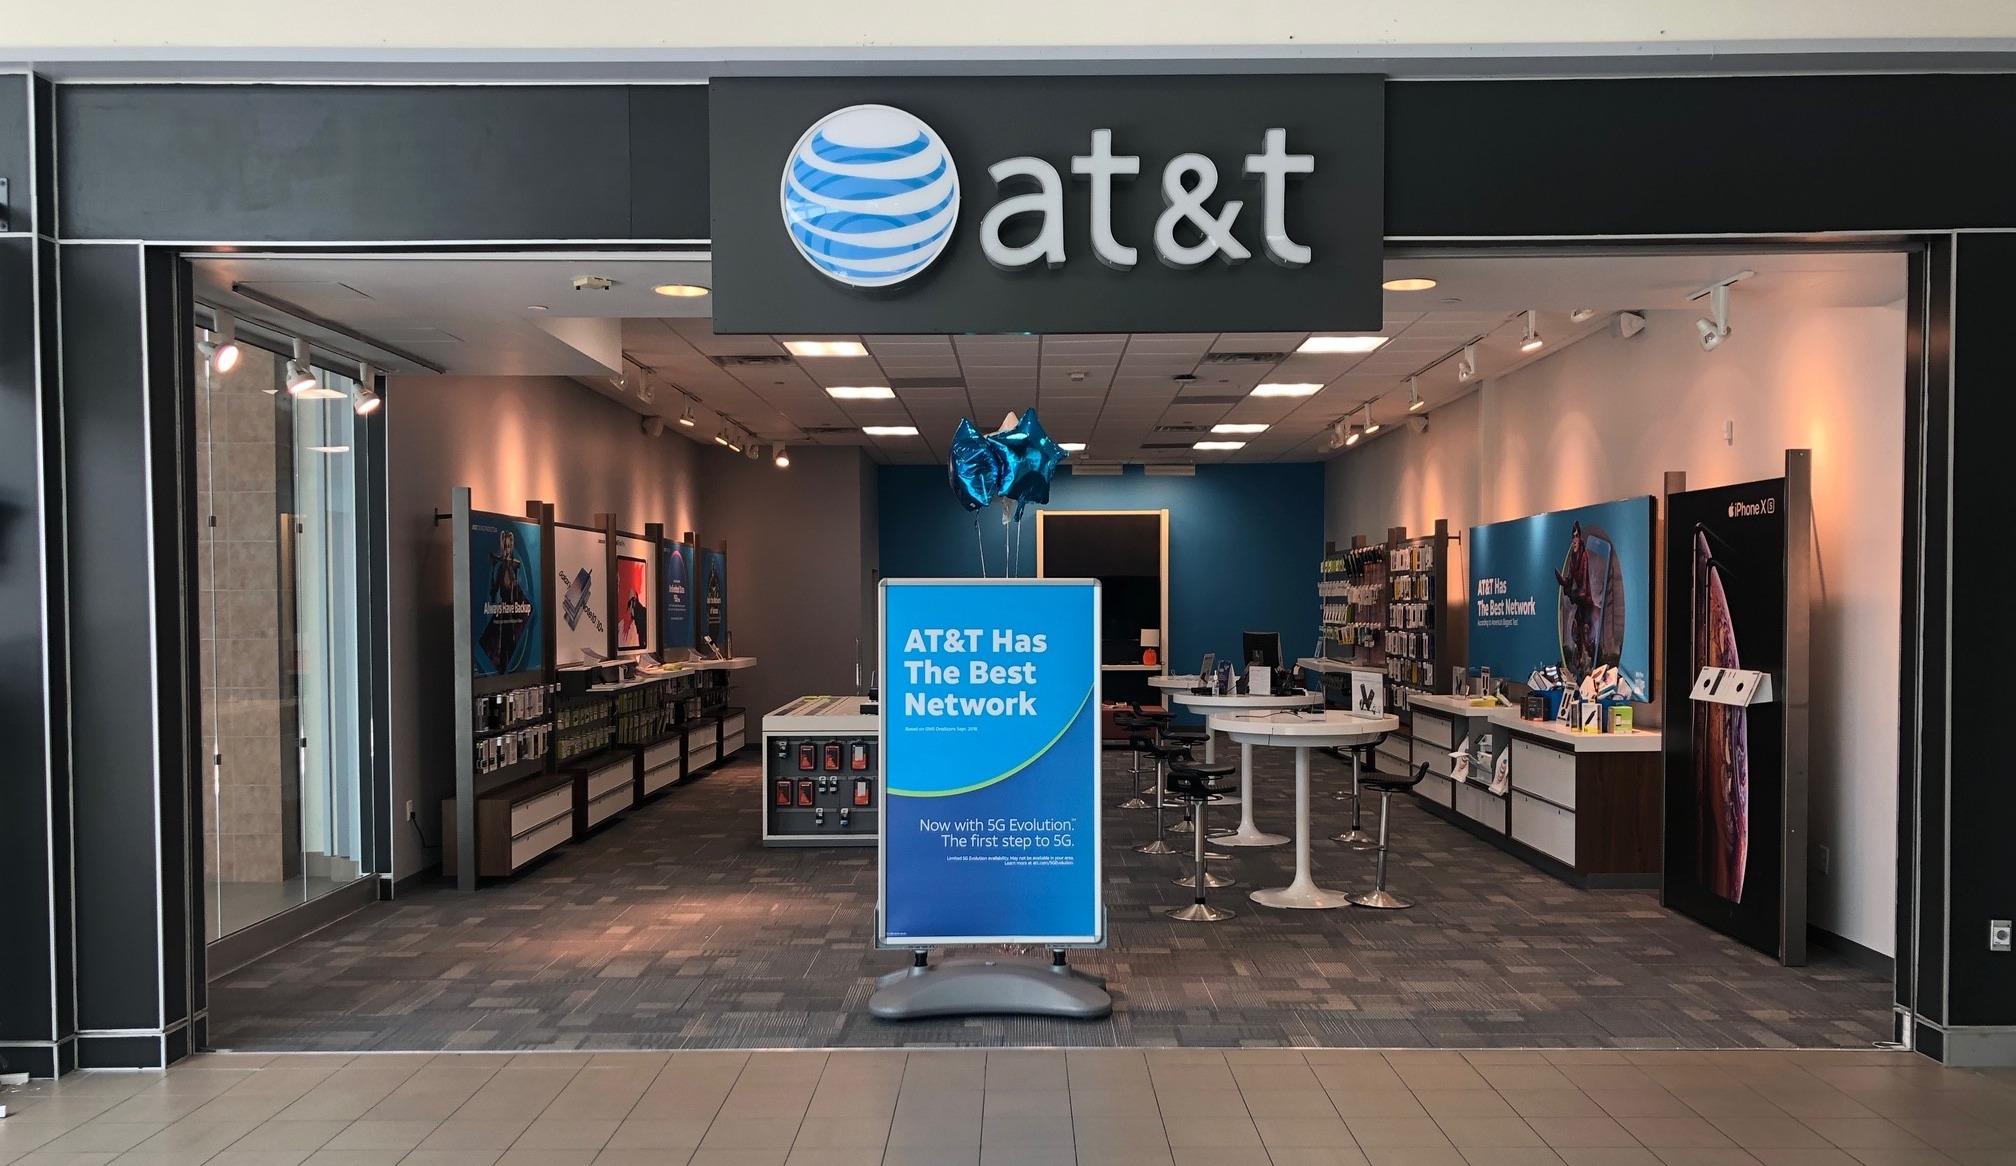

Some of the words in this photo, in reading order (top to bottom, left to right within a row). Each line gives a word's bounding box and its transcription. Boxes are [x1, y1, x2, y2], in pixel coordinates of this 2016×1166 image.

[980, 127, 1316, 270] at&t
[1734, 501, 1760, 517] iPhone
[1477, 578, 1494, 596] AT&T
[1494, 577, 1507, 595] Has
[483, 601, 503, 617] Always
[502, 602, 515, 614] Have
[514, 601, 532, 616] Backup
[1477, 599, 1489, 617] The
[1489, 599, 1505, 616] Best
[1505, 596, 1536, 616] Network
[903, 628, 984, 653] AT&T
[992, 628, 1048, 653] Has
[903, 659, 961, 685] The
[969, 660, 1037, 685] Best
[904, 690, 1038, 716] Network
[919, 818, 951, 832] Now
[954, 817, 984, 832] with
[987, 818, 1006, 832] 5G
[941, 834, 968, 847] The
[970, 833, 999, 848] first
[1001, 835, 1032, 850] step
[1034, 835, 1051, 848] to
[1053, 834, 1075, 847] 5G.
